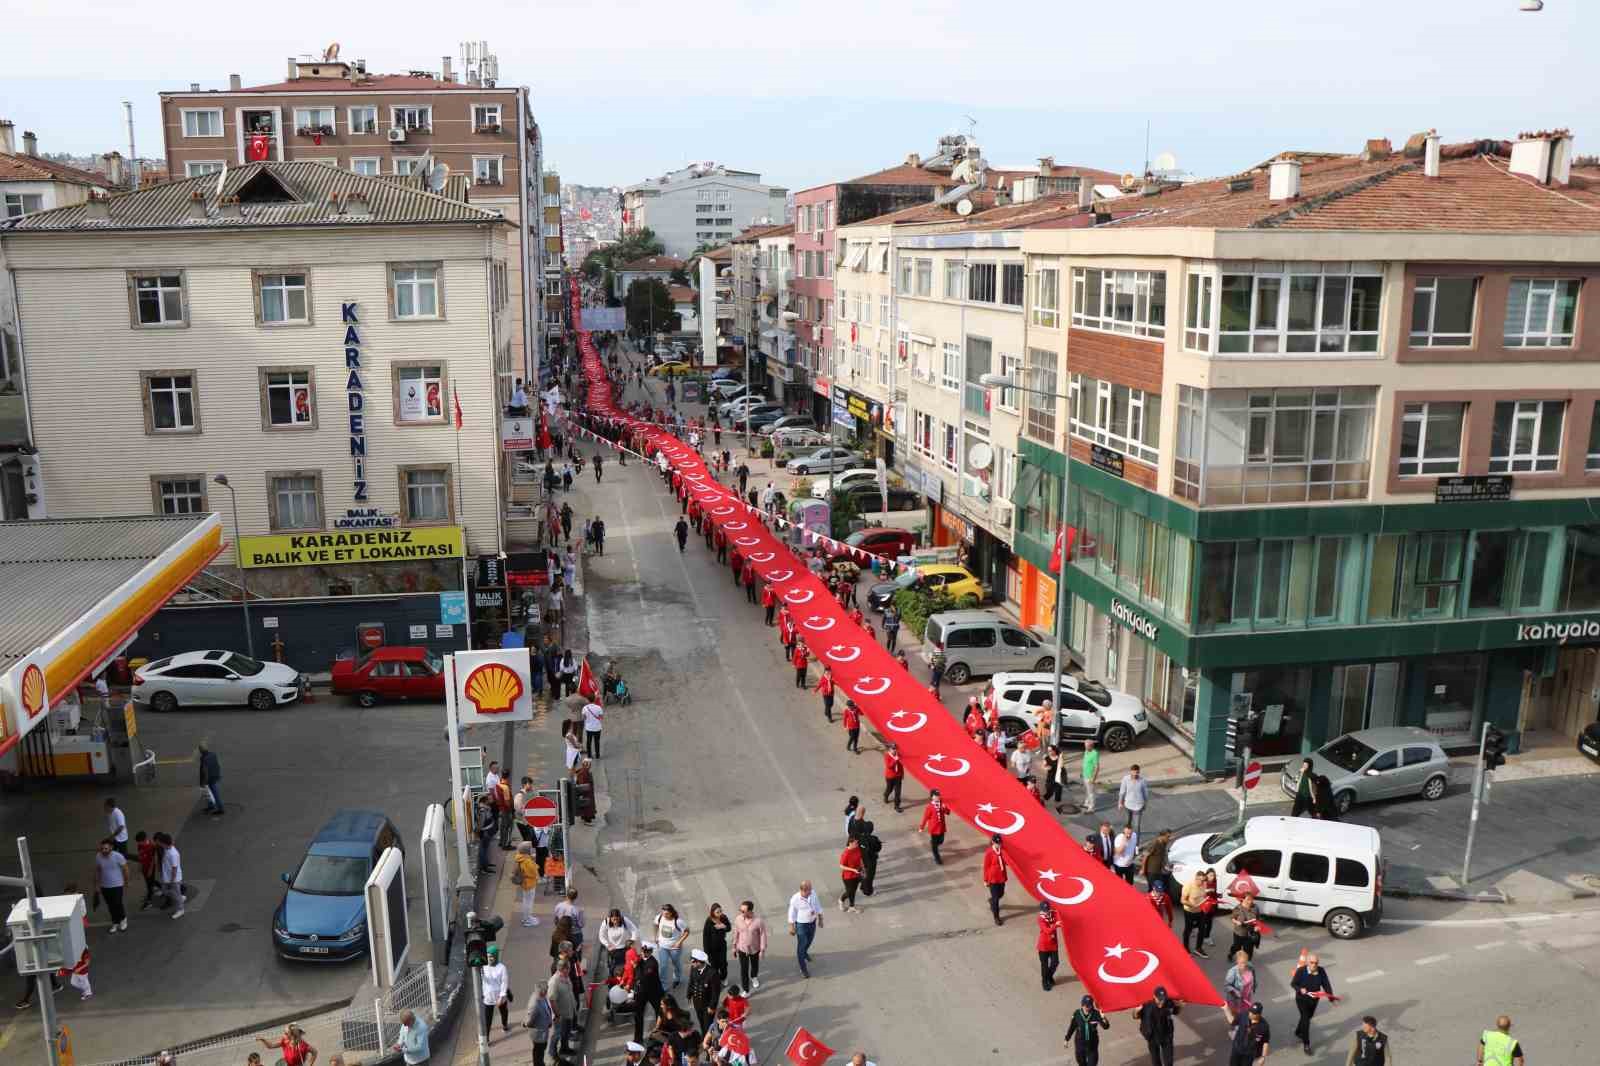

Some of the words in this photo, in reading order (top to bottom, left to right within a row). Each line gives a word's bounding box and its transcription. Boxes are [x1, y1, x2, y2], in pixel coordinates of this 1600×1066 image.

[347, 508, 378, 518] BALIK
[334, 517, 393, 528] LOKANTASI
[253, 550, 306, 565] BALIK
[308, 550, 329, 562] VE
[334, 548, 354, 561] ET
[360, 543, 453, 560] LOKANTASI
